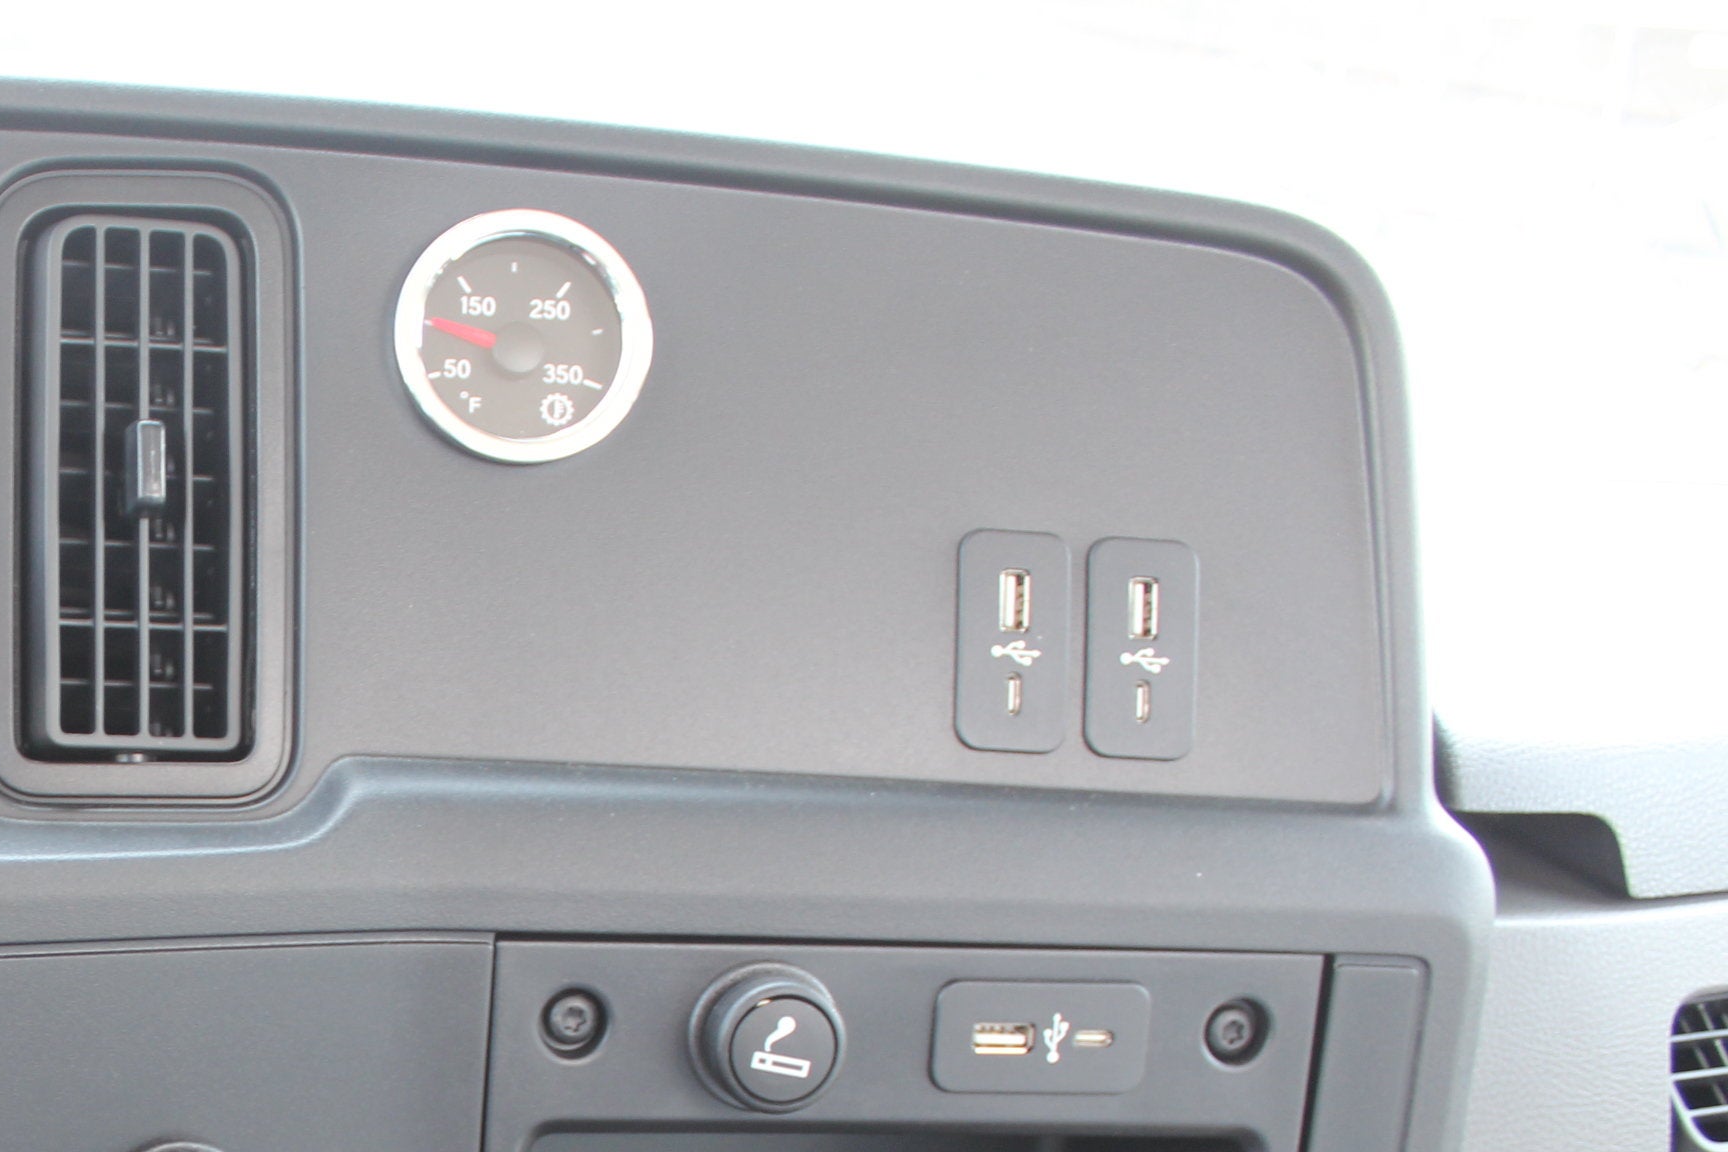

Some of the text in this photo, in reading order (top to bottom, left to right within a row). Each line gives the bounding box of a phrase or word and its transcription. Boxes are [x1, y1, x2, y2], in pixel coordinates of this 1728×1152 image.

[461, 296, 496, 316] 150
[529, 299, 570, 319] 250
[444, 359, 471, 378] 50
[543, 364, 582, 385] 350
